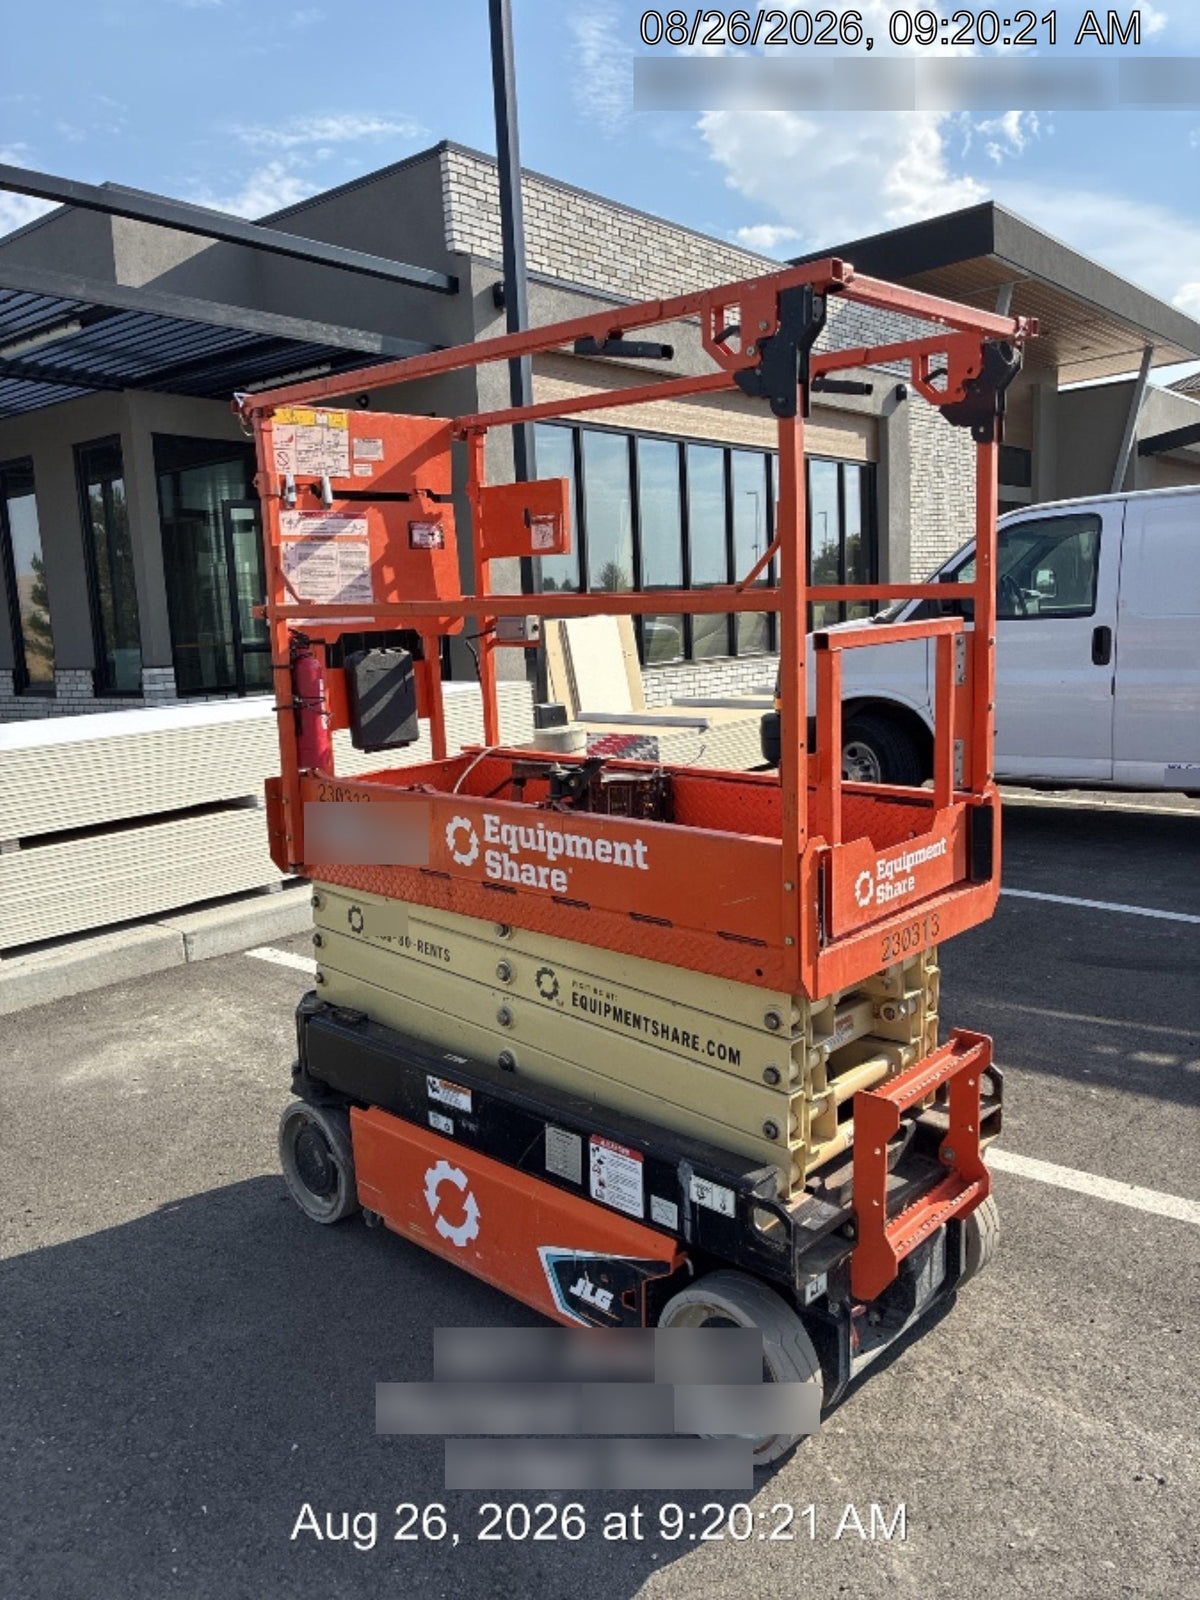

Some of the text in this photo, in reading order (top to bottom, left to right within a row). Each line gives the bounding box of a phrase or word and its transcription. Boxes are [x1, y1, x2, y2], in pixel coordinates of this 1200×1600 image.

[482, 813, 649, 870] Equipment
[876, 837, 947, 880] Equipment
[485, 849, 568, 893] Share
[876, 876, 915, 904] Share
[881, 913, 940, 961] 230313
[571, 992, 741, 1066] EQUIPMENTSHARE.COM
[568, 1277, 614, 1310] JLG
